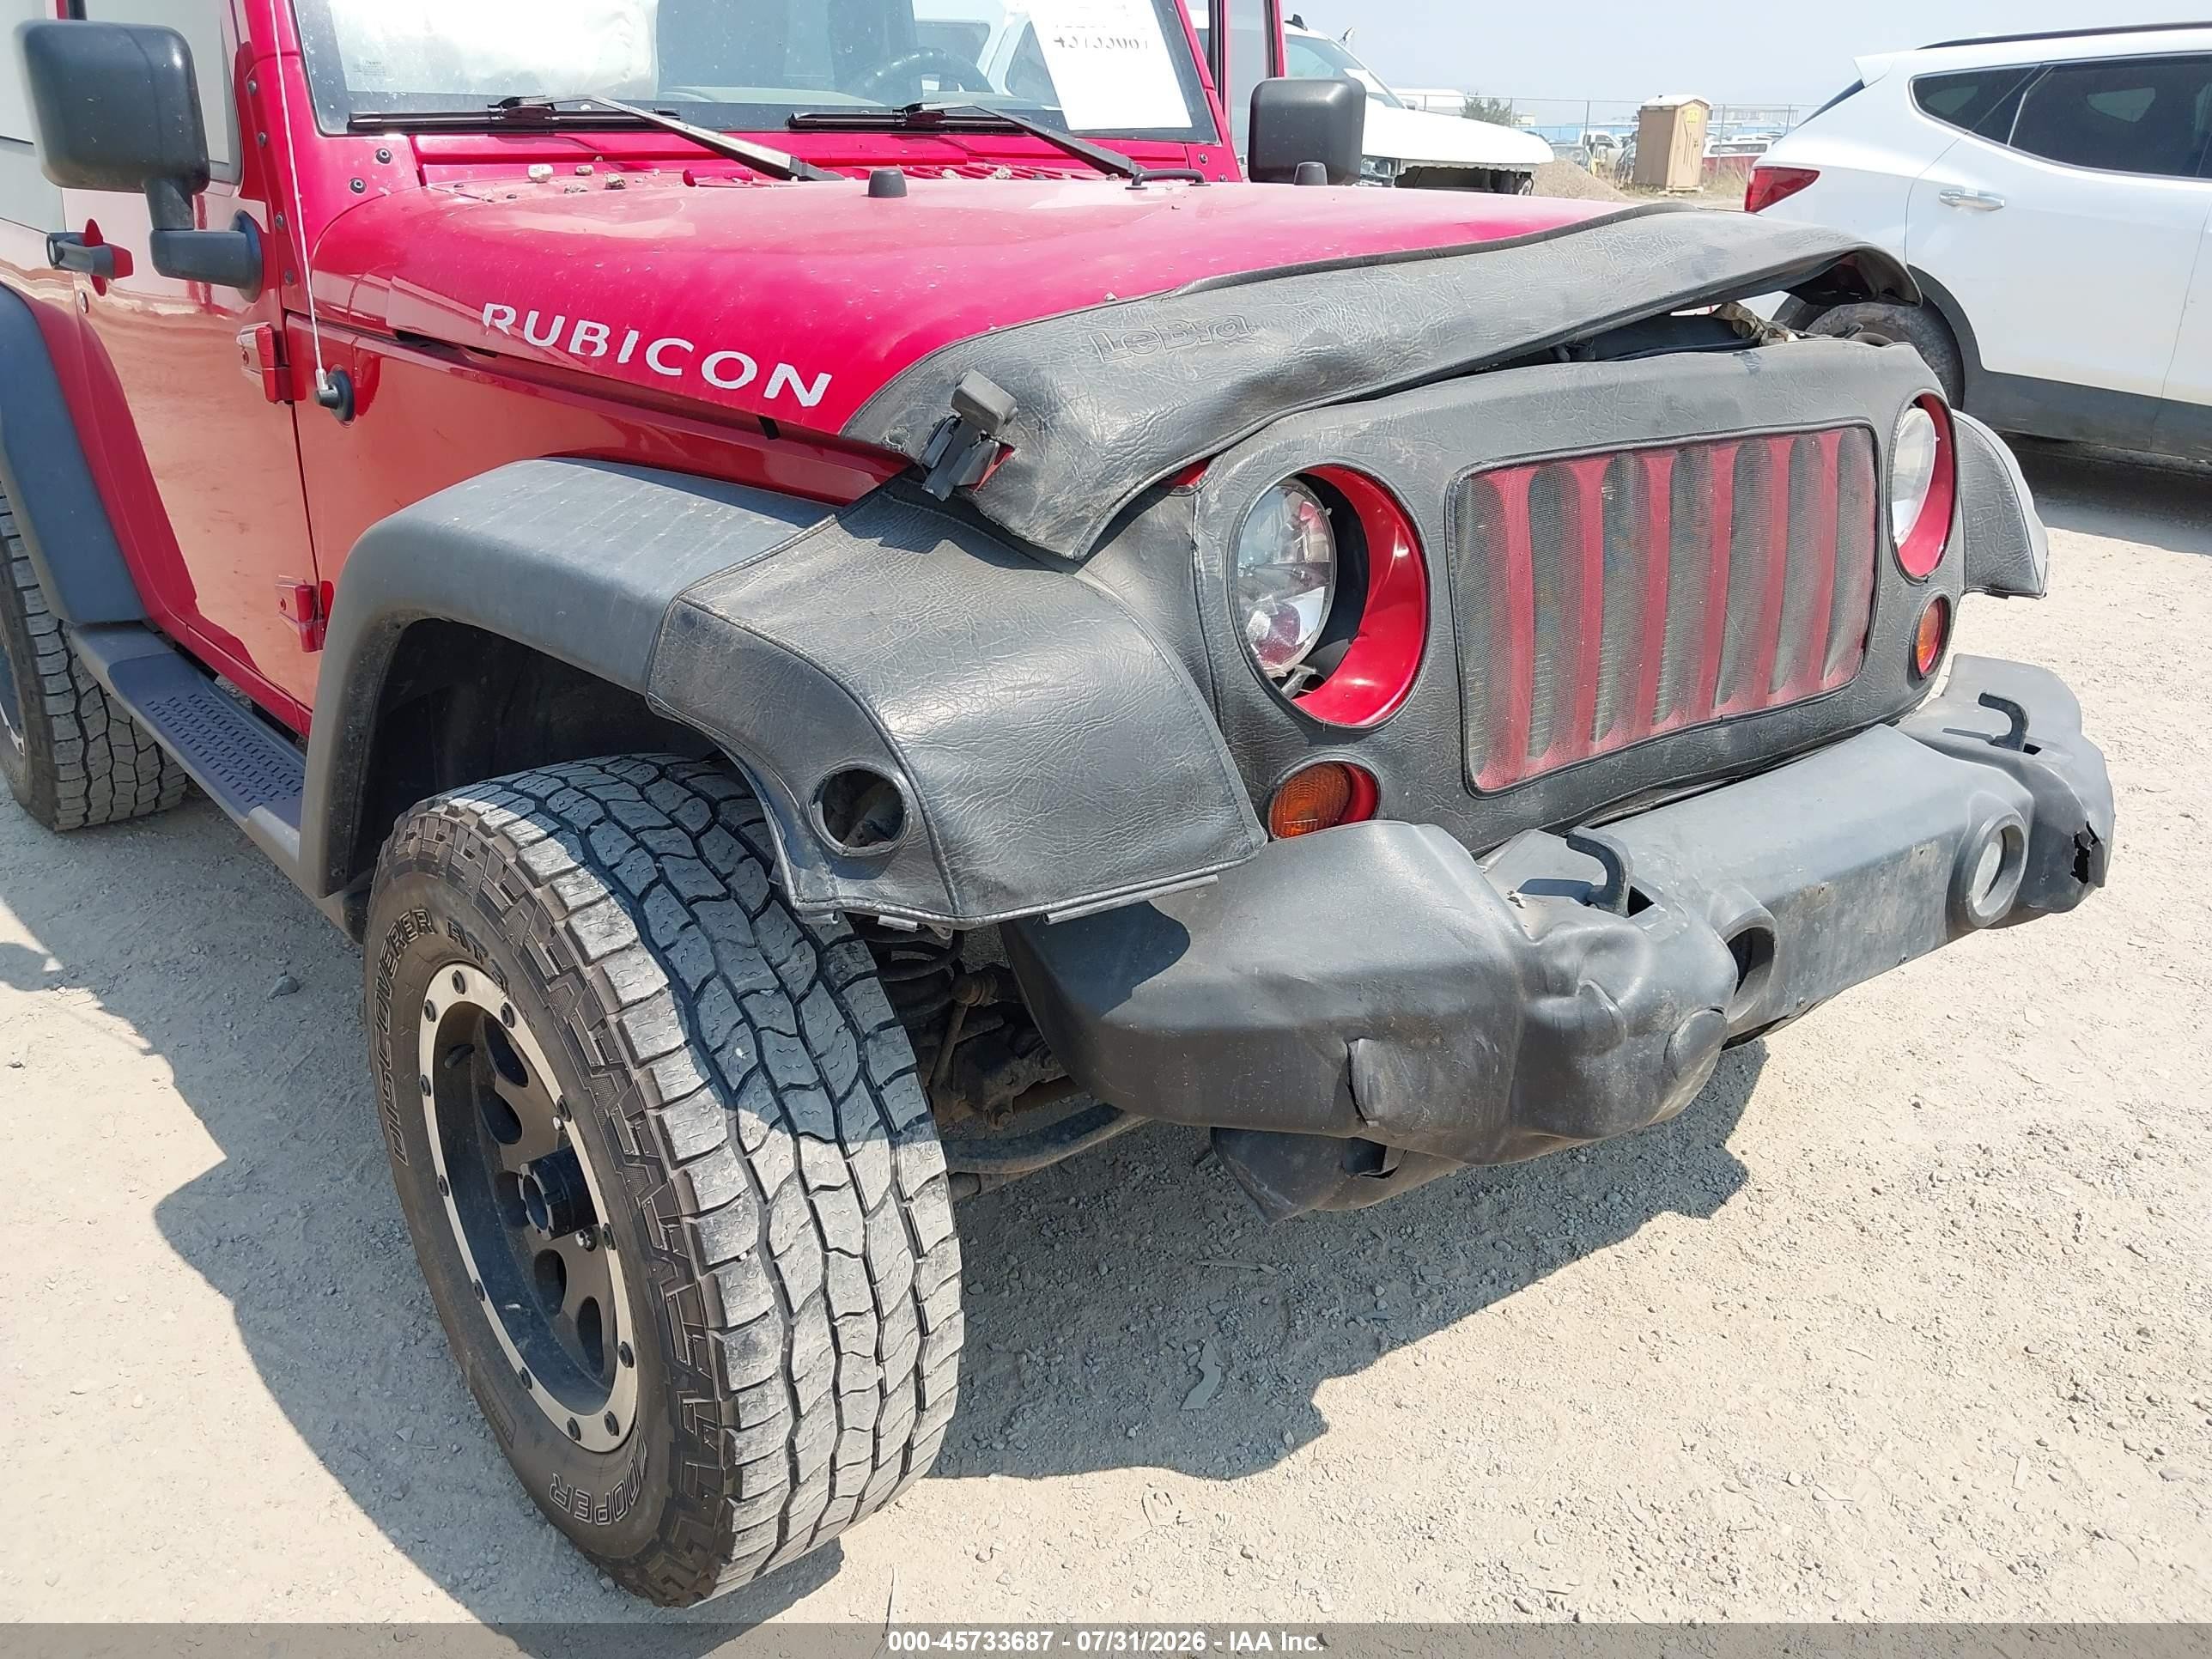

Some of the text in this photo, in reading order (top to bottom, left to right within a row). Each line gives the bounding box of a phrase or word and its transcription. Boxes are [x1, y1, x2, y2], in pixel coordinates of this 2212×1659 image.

[483, 302, 833, 408] RUBICON
[1088, 314, 1252, 364] LeBra
[374, 908, 435, 1167] DISCOVERER
[549, 1420, 647, 1526] COOPER
